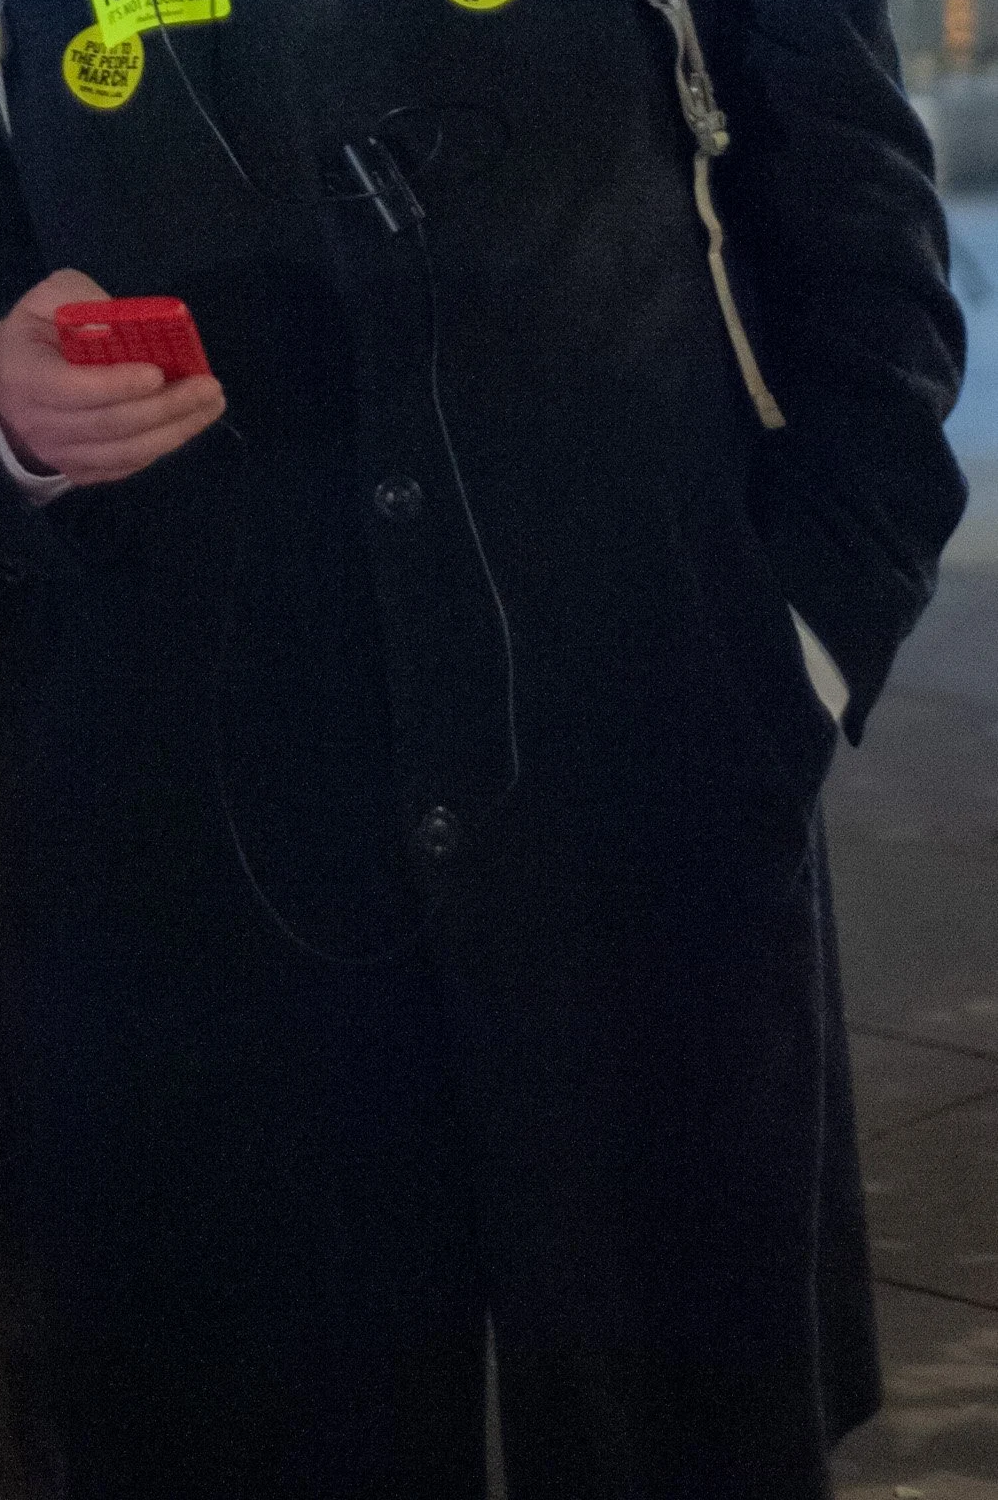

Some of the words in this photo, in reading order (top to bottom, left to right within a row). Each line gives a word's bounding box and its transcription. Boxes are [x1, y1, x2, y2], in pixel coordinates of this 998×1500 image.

[71, 49, 96, 66] THE
[99, 55, 139, 69] PEOPLE
[78, 66, 129, 86] MARCH
